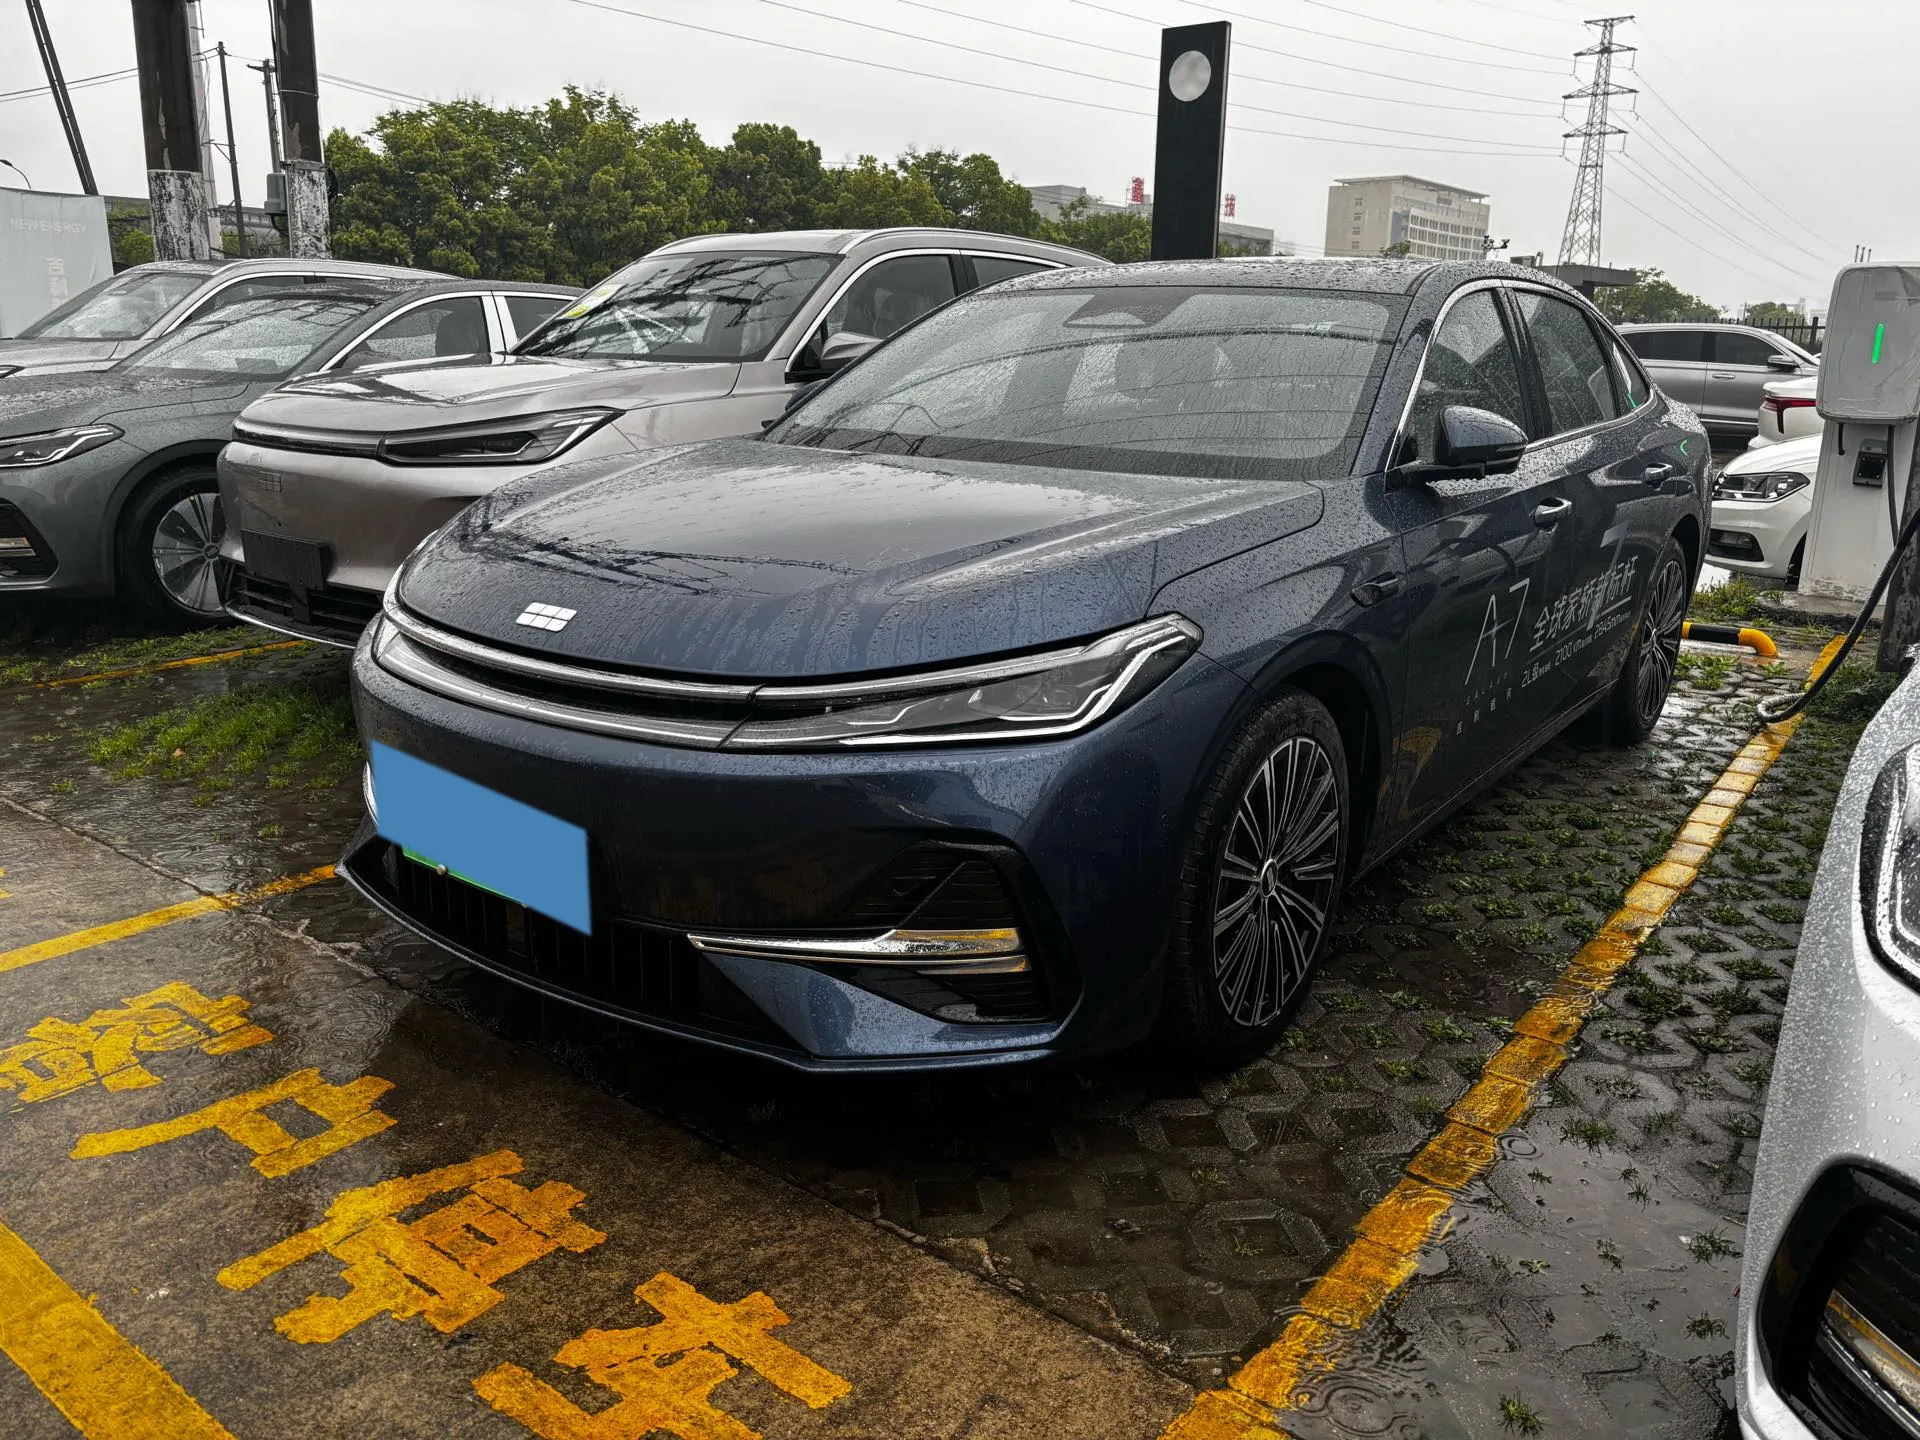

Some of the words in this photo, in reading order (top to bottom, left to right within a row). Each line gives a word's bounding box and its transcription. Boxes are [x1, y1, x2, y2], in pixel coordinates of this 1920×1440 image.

[10, 217, 38, 231] NEW
[39, 220, 87, 234] ENERGY
[1464, 577, 1530, 686] A7
